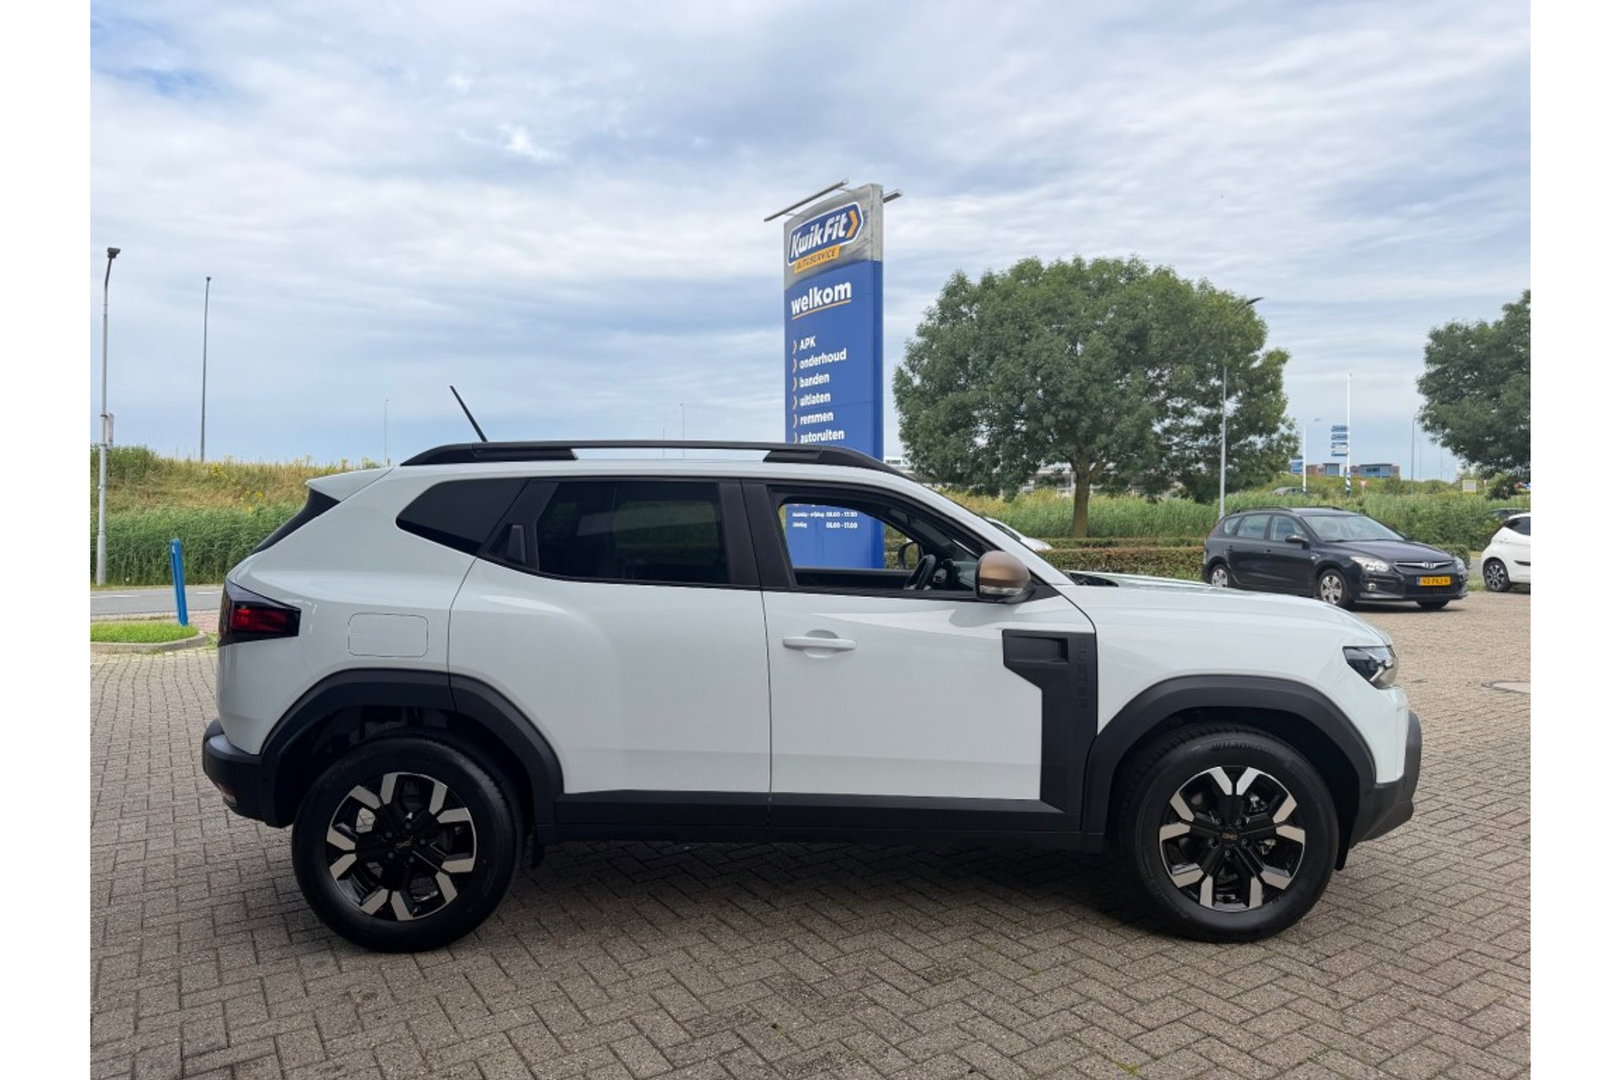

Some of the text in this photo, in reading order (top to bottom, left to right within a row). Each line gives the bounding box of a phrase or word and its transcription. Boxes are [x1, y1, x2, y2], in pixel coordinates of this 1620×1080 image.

[791, 281, 852, 316] welkom
[799, 335, 816, 351] APK
[799, 347, 848, 370] onderhoud
[799, 373, 830, 388] banden
[799, 392, 832, 407] uitlaten
[800, 411, 834, 425] remmen
[800, 428, 846, 444] autoruiten
